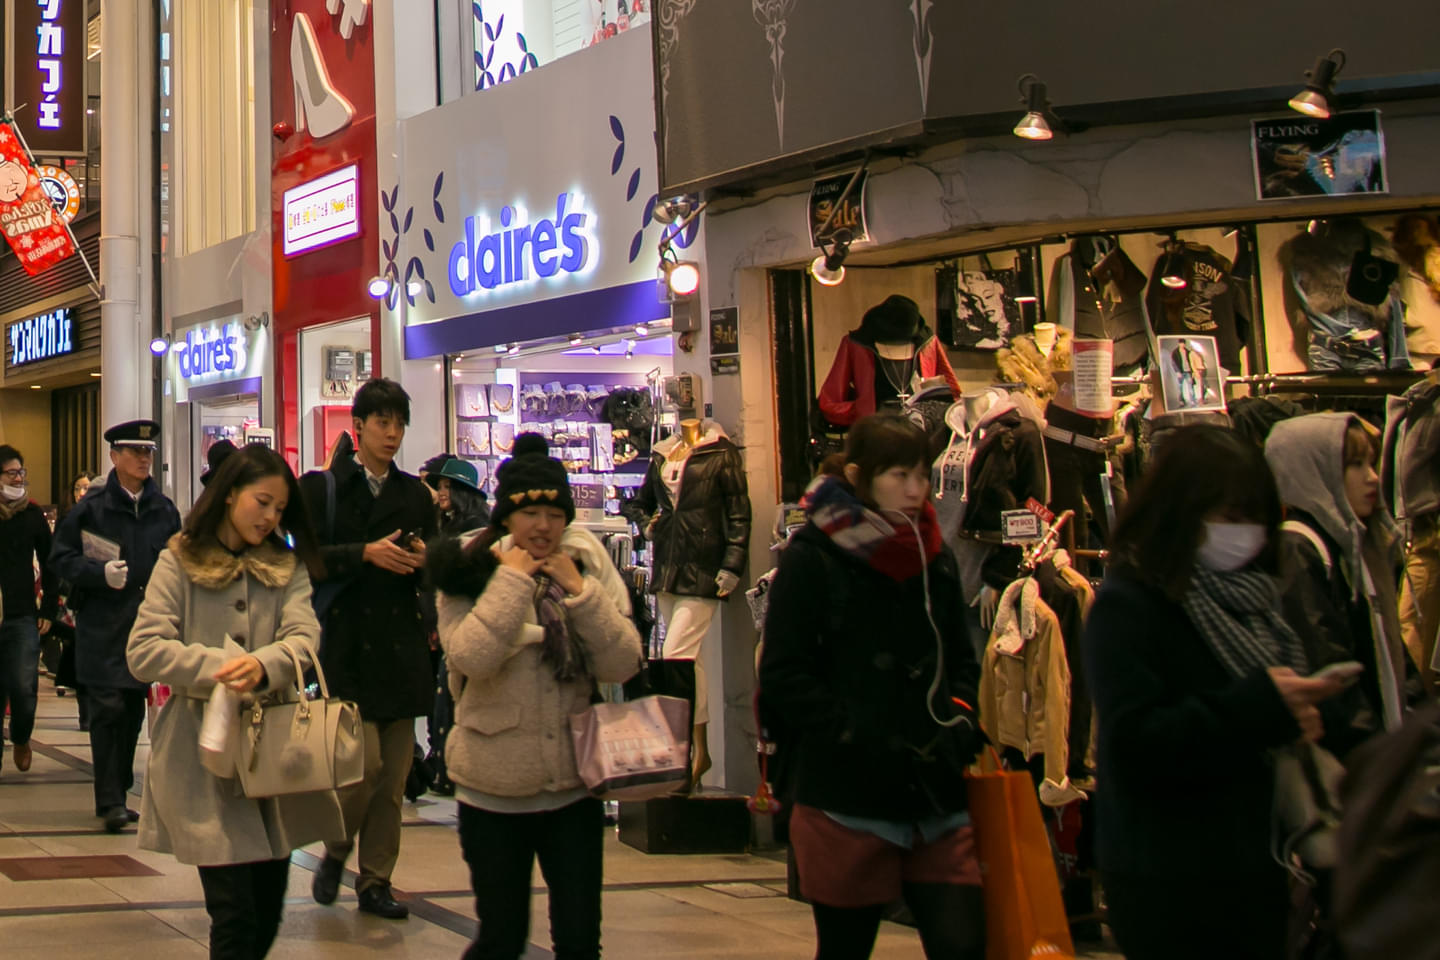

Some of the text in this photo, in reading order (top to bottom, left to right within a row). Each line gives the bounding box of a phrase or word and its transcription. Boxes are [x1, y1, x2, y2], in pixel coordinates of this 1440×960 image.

[1257, 124, 1319, 140] FLYING
[448, 193, 590, 297] claire's
[11, 308, 72, 365] サンマルクカフェ
[179, 324, 240, 378] claire's
